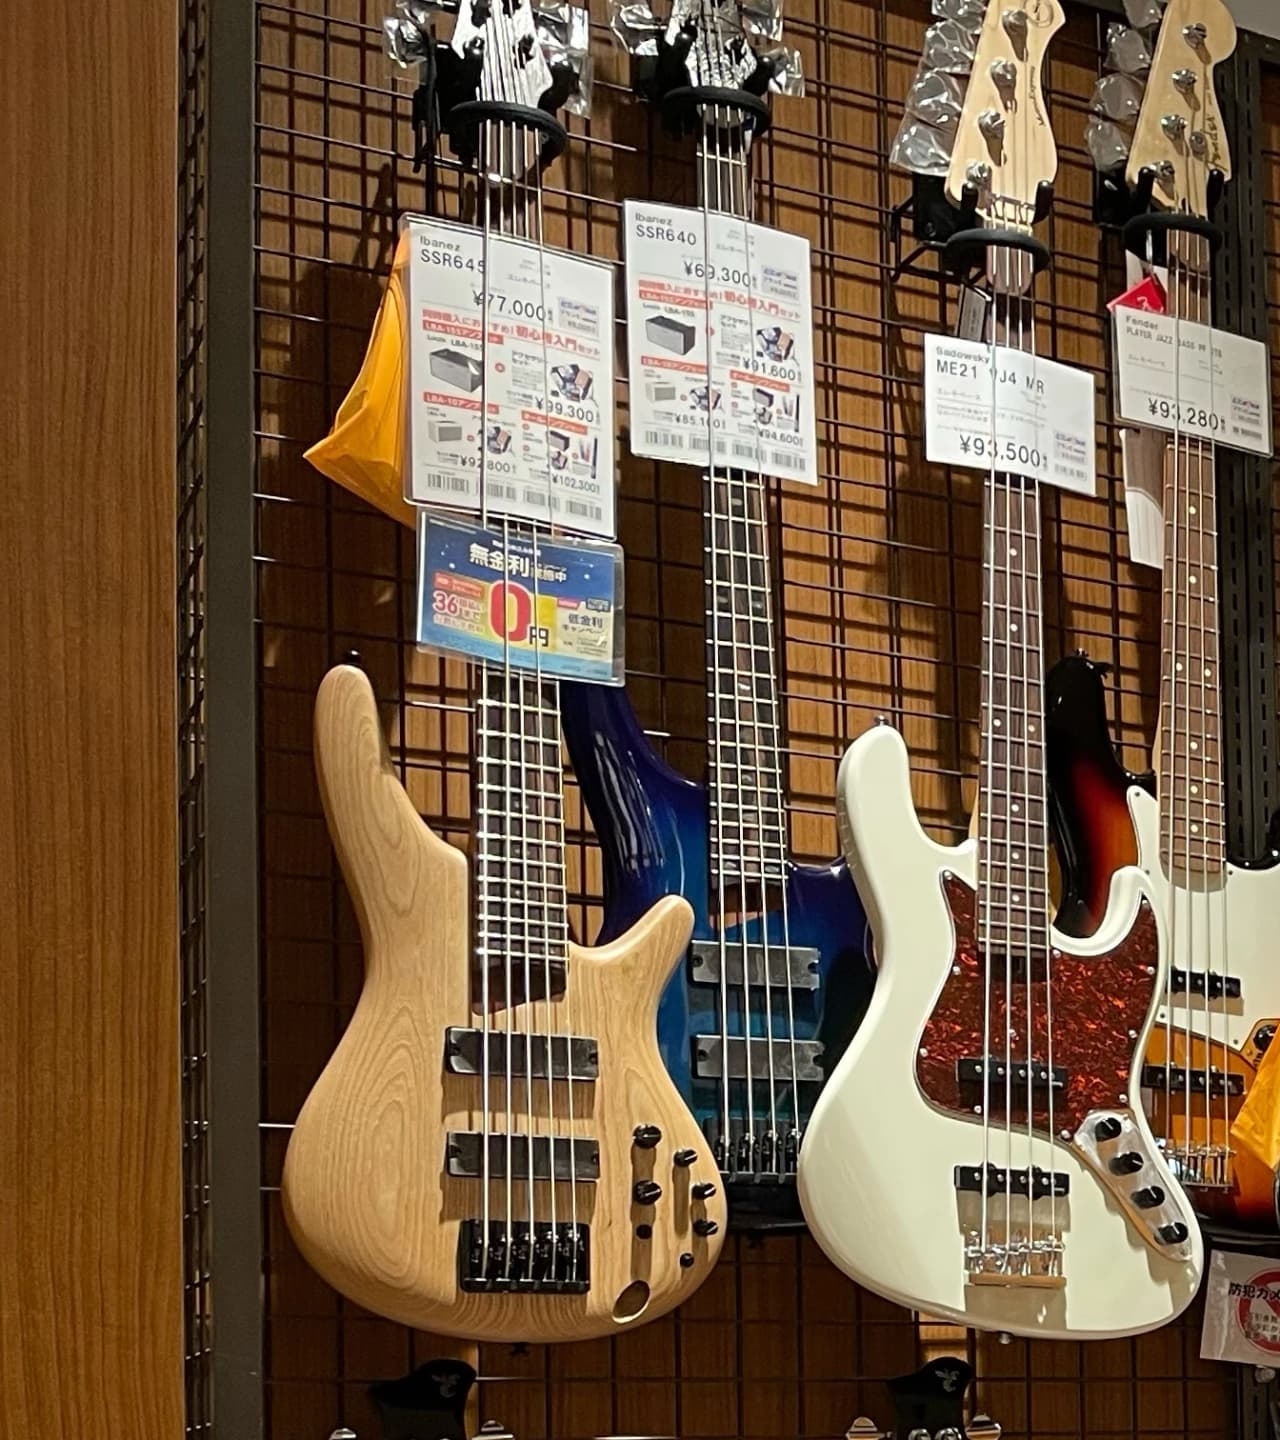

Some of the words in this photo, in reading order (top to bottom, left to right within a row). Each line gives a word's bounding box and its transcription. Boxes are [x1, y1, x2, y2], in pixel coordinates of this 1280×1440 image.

[634, 213, 673, 227] Ibanez
[420, 235, 461, 252] Ibanez
[636, 225, 697, 246] SSR640
[936, 359, 978, 380] ME21
